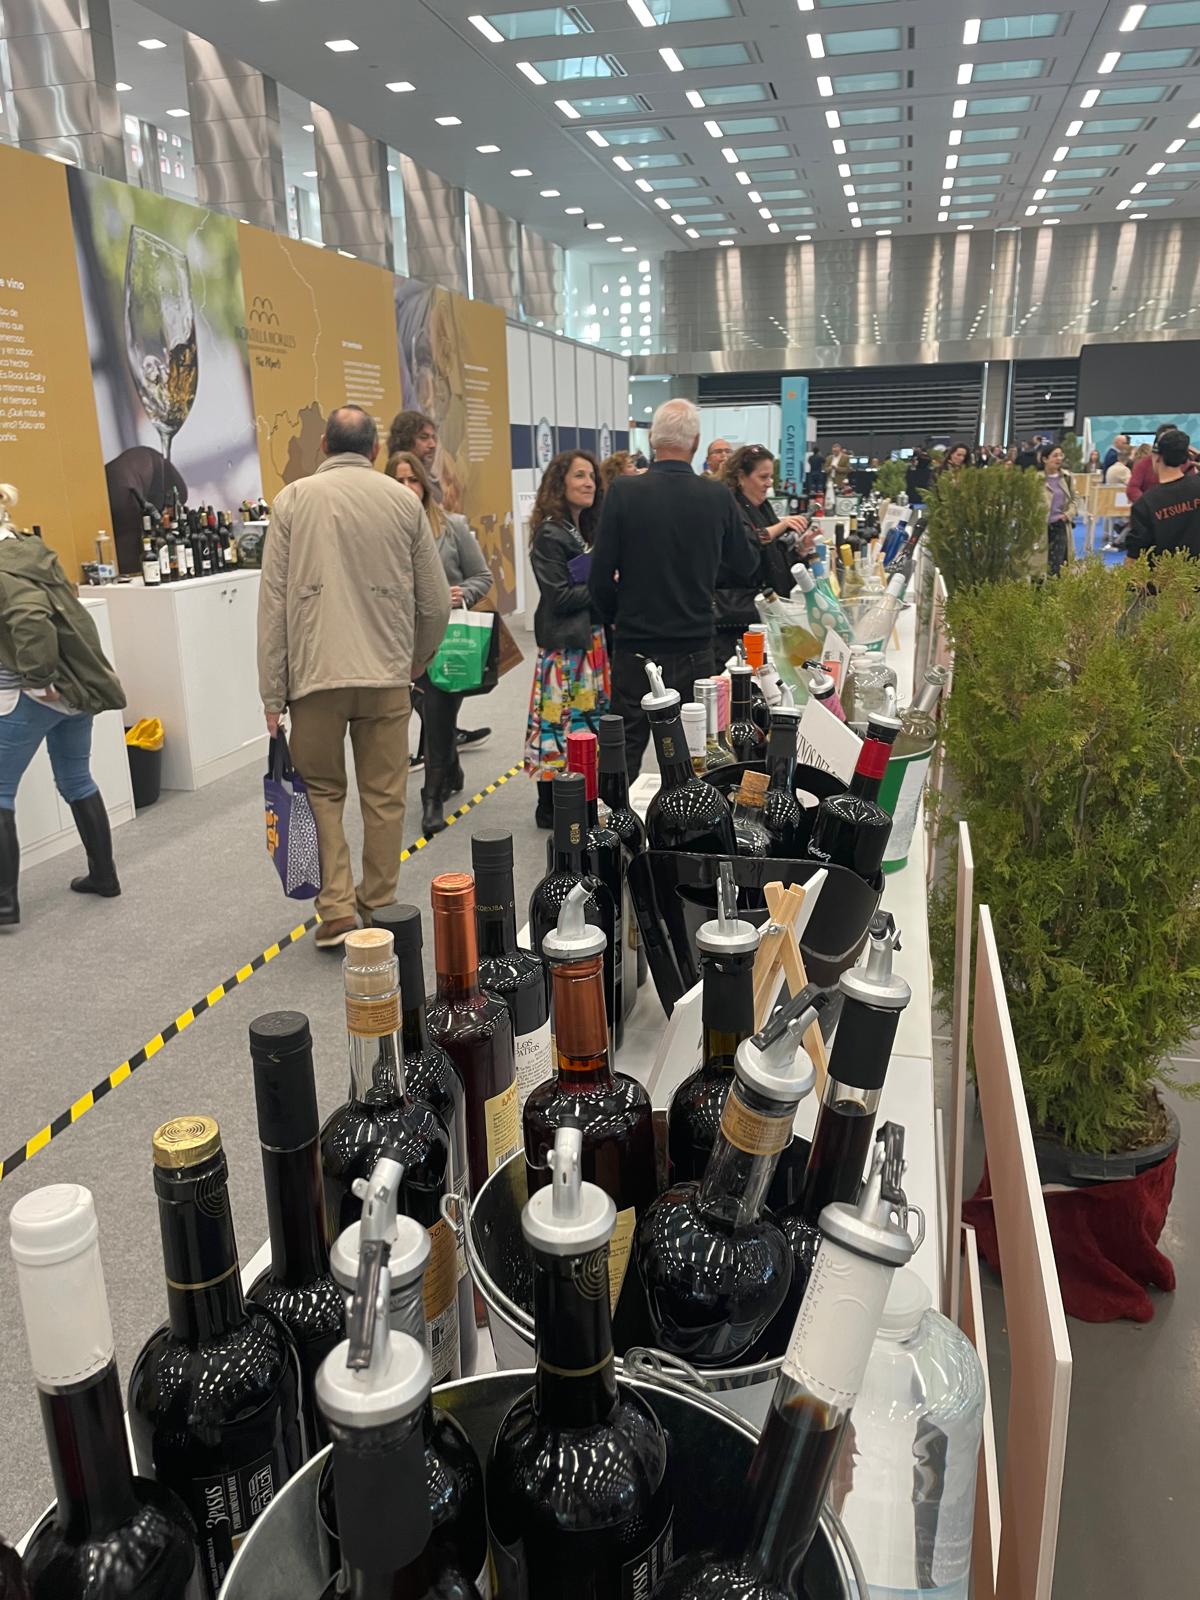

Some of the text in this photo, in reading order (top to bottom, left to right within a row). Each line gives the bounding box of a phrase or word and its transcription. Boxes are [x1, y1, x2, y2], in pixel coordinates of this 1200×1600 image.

[7, 278, 25, 290] vino
[8, 371, 24, 380] Rock
[1155, 501, 1194, 520] VISUAL
[797, 1257, 833, 1354] ORGANIC
